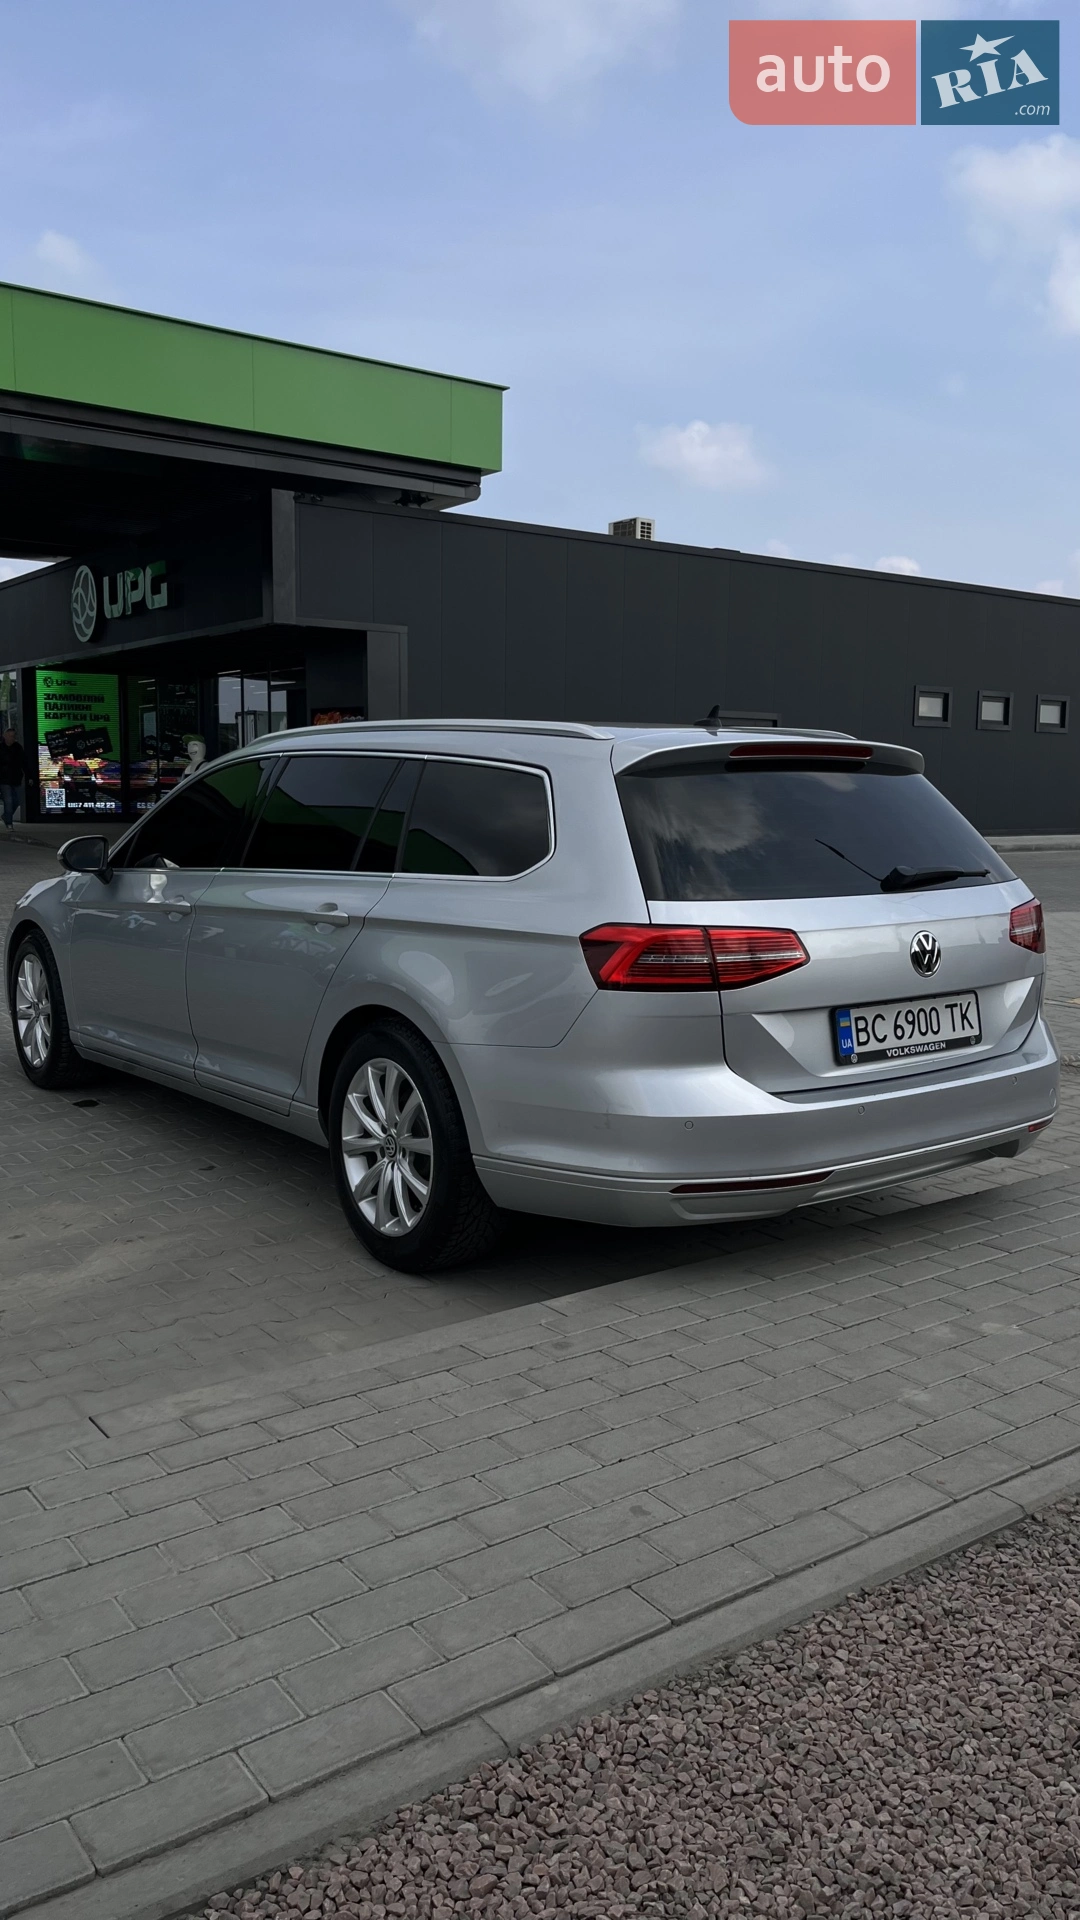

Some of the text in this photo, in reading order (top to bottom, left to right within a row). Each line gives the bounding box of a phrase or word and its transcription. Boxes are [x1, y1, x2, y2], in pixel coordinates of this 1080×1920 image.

[103, 560, 168, 619] UPG
[44, 711, 88, 722] КАРТКИ
[854, 1001, 975, 1047] BC 6900 TK
[841, 1038, 853, 1049] UA
[886, 1041, 946, 1058] VOLKSWAGEN
